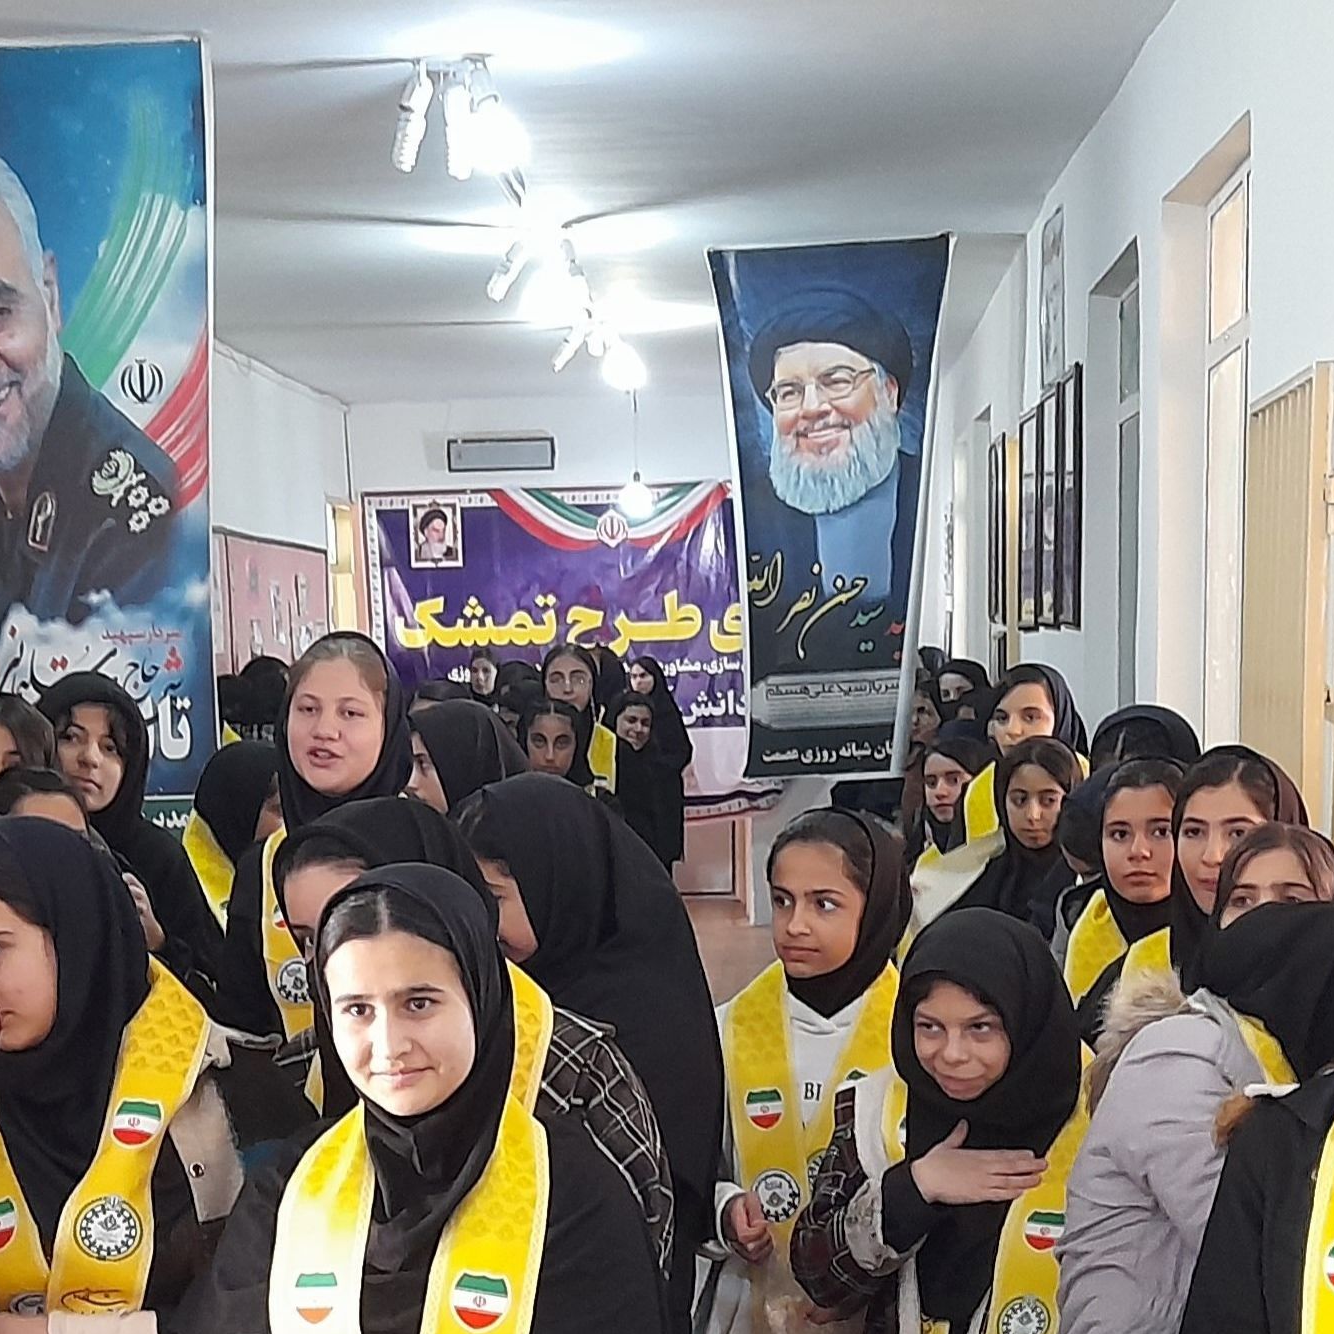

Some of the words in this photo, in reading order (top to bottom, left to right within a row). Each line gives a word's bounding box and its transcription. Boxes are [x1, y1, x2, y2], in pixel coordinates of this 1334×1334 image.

[393, 593, 557, 649] تمشک
[565, 588, 703, 656] طرح
[800, 746, 838, 764] روزی
[839, 741, 873, 760] شبانه
